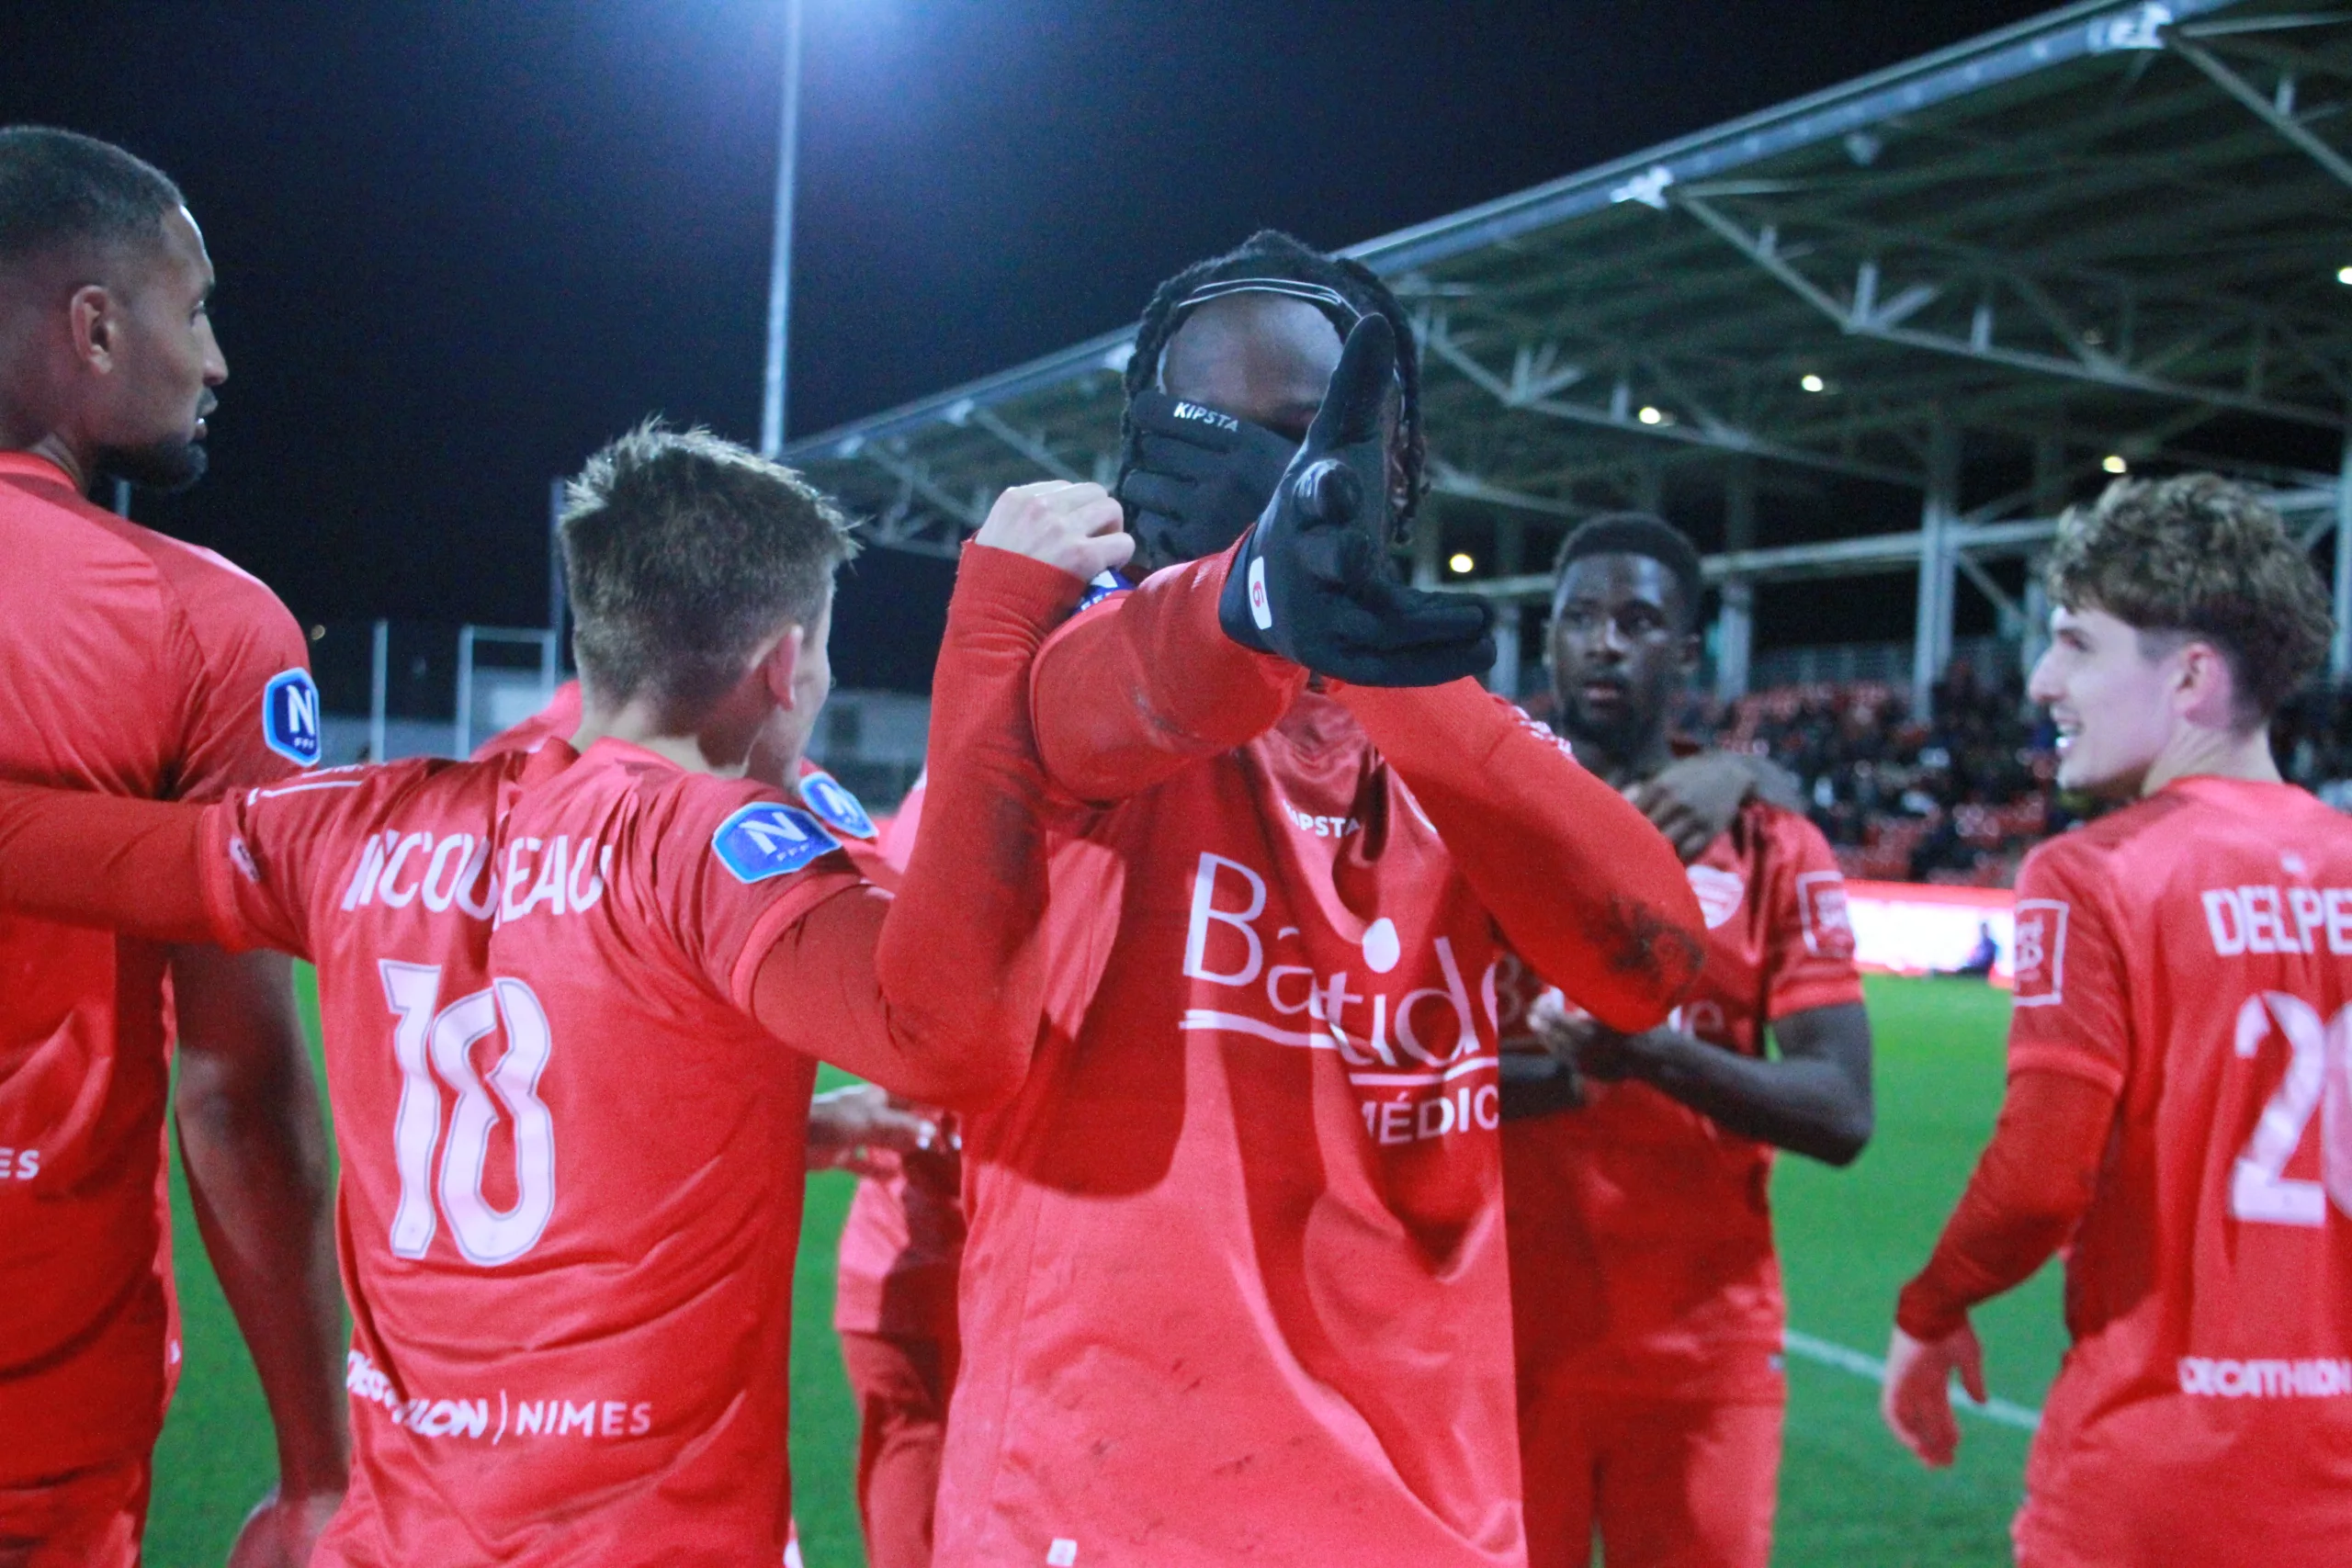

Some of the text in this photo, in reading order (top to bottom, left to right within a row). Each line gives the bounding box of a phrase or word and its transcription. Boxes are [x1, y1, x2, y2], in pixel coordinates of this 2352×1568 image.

[1173, 401, 1239, 433] KIPSTA
[287, 686, 315, 736] N
[738, 812, 808, 855] N
[2199, 886, 2352, 957] DELPE
[378, 958, 556, 1267] 18
[515, 1399, 652, 1438] NIMES
